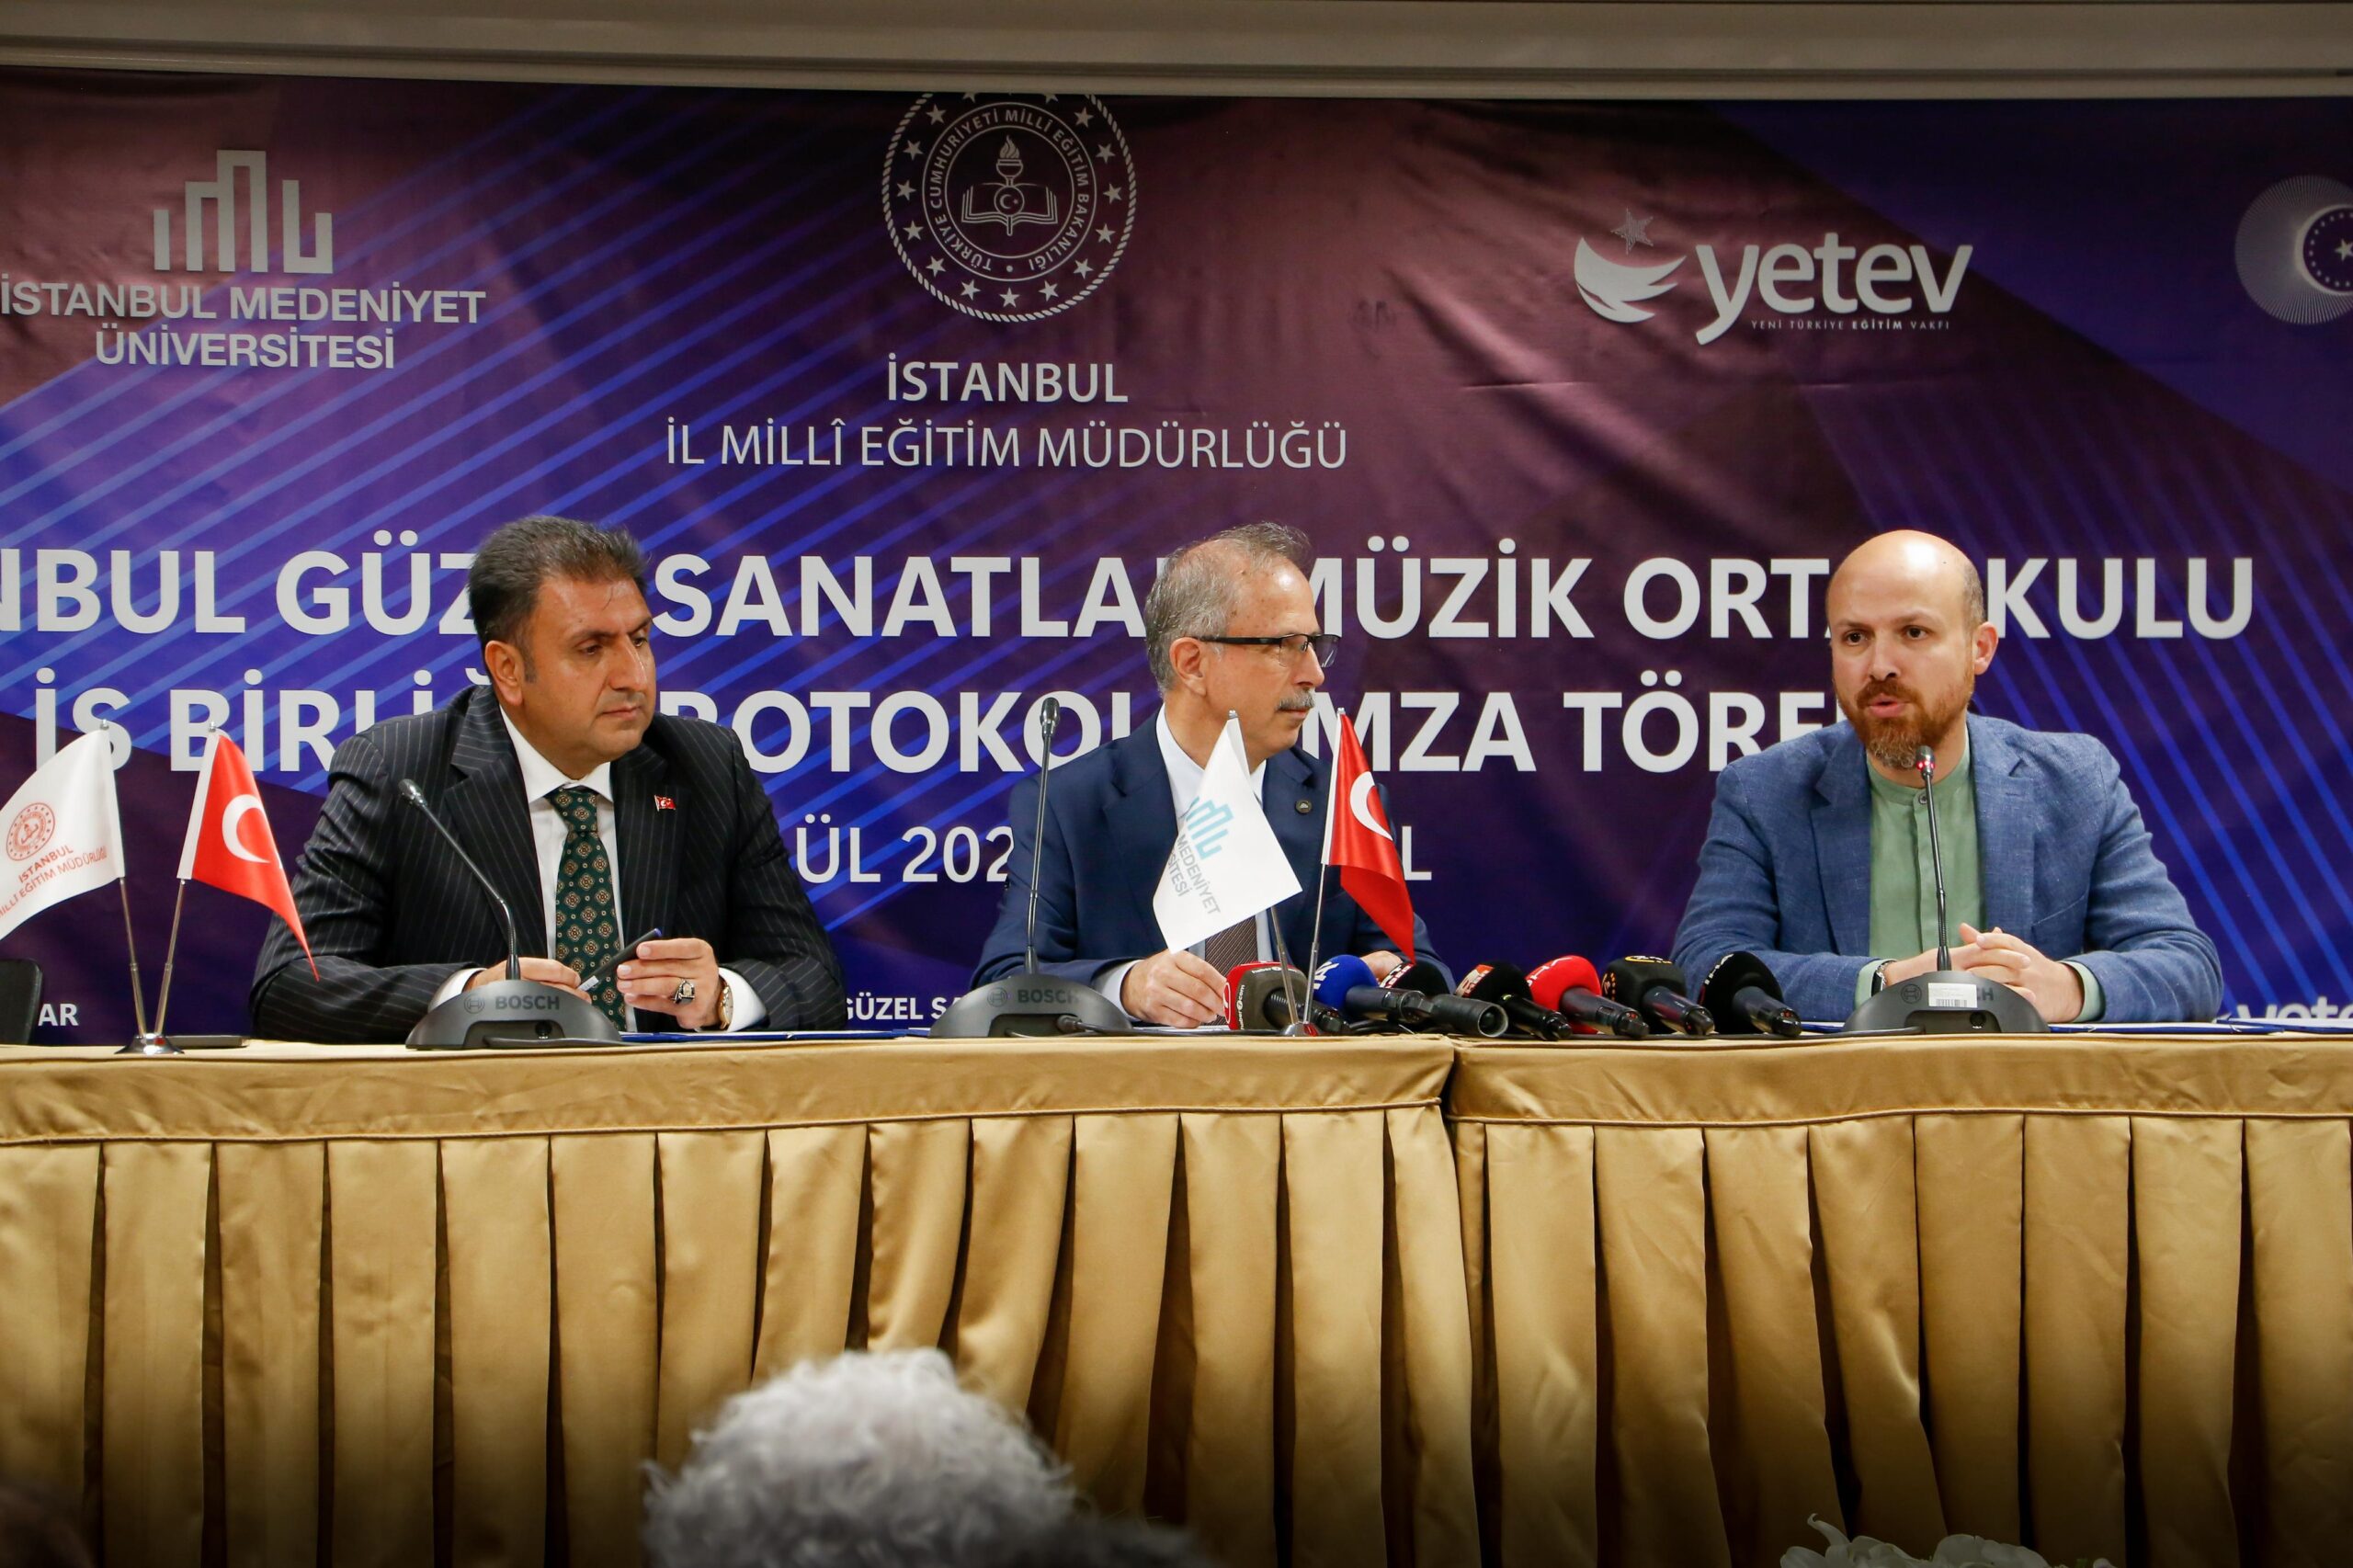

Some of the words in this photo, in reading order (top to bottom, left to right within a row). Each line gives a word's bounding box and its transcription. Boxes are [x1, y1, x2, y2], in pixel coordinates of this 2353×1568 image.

[930, 108, 999, 209] CUMHURİYETİ
[1053, 130, 1089, 187] EĞİTİM
[935, 214, 992, 271] TÜRKİYE
[1028, 194, 1089, 271] BAKANLIĞI
[1, 273, 216, 319] İSTANBUL
[230, 282, 486, 324] MEDENİYET
[1695, 232, 1973, 346] yetev
[96, 323, 395, 369] ÜNİVERSİTESİ
[1750, 317, 1783, 330] YENİ
[1790, 317, 1844, 330] TÜRKİYE
[1851, 317, 1903, 330] EĞİTİM
[888, 352, 1128, 403] İSTANBUL
[667, 416, 705, 465] İL
[721, 416, 845, 467] MİLLÎ
[861, 417, 1020, 468] EĞİTİM
[1037, 421, 1347, 470] MÜDÜRLÜĞÜ
[276, 529, 478, 636] GÜZ
[654, 553, 1169, 638] SANATLA
[1302, 691, 1537, 773] MZA
[901, 825, 1015, 883] 202
[1177, 834, 1222, 915] MEDENİYET
[494, 994, 560, 1010] BOSCH
[1017, 988, 1079, 1005] BOSCH
